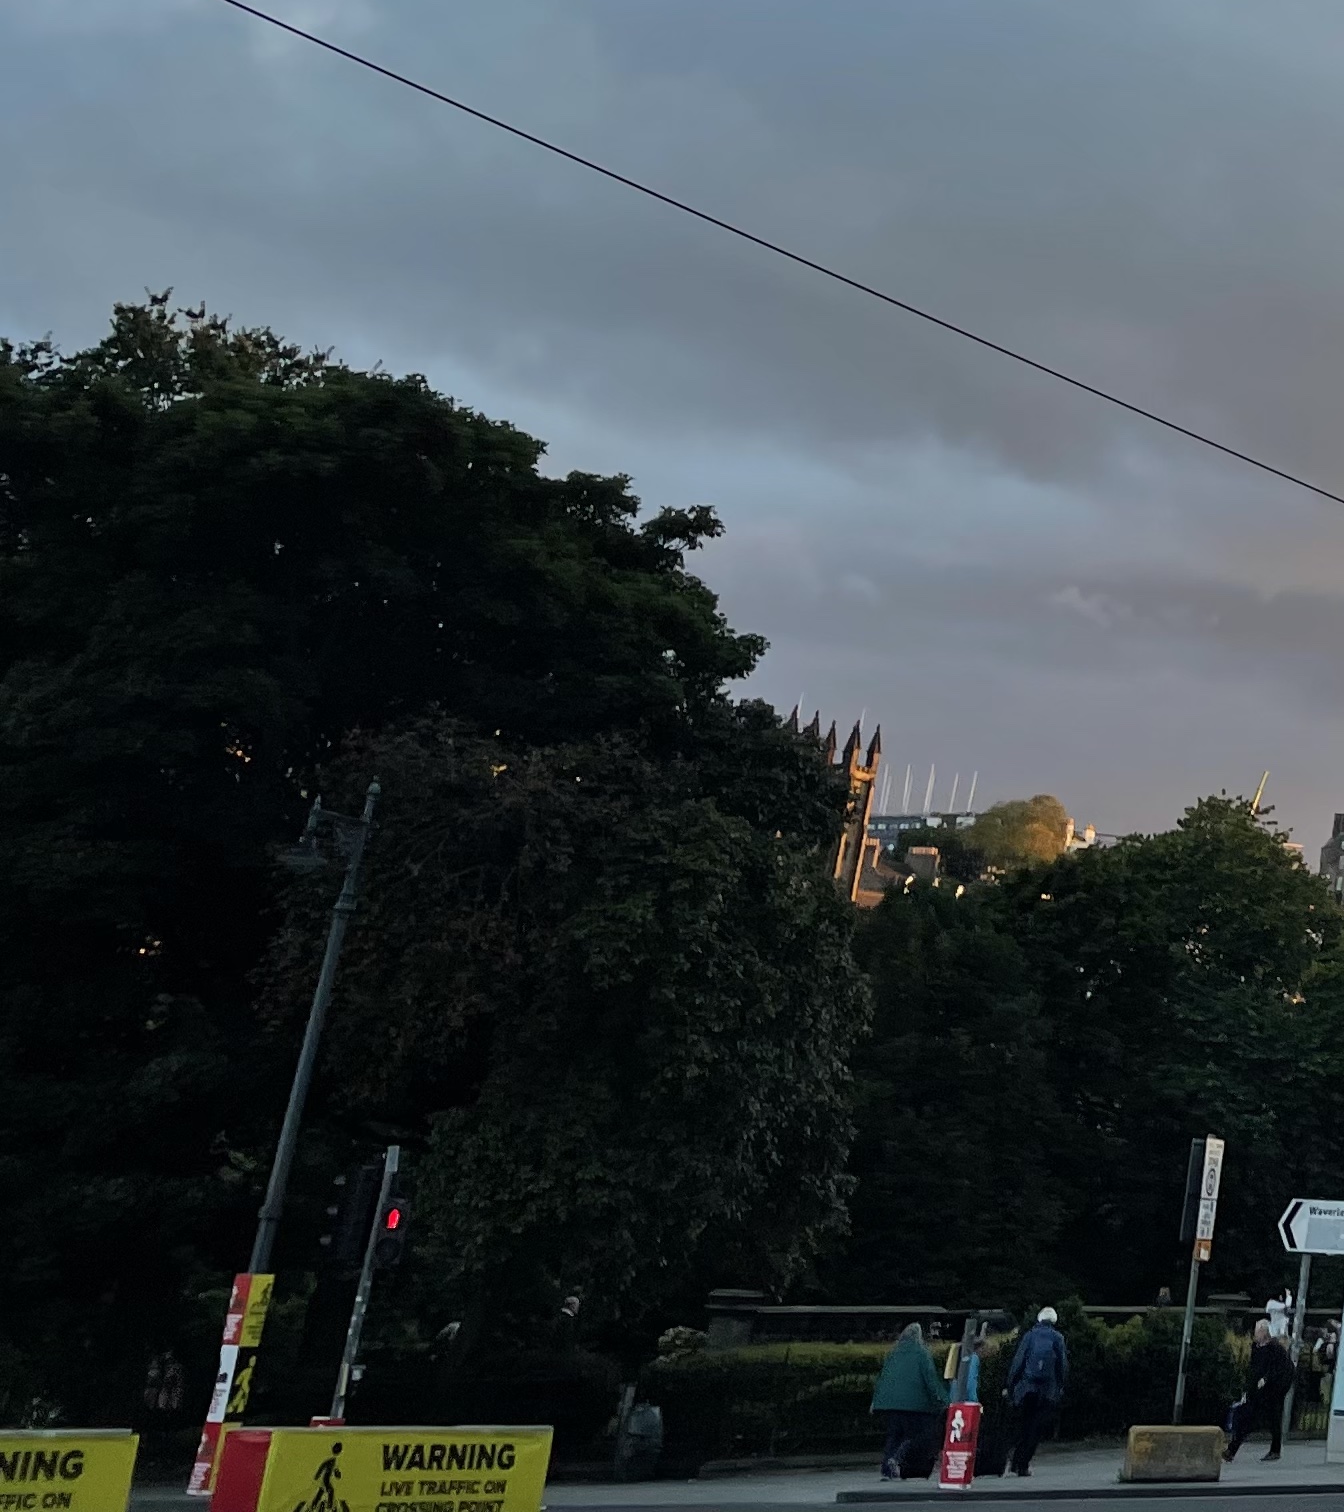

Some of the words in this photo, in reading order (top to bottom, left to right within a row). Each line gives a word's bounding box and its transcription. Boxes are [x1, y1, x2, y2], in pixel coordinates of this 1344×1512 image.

[383, 1444, 515, 1471] WARNING
[379, 1480, 413, 1497] LIVE
[418, 1480, 480, 1495] TRAFFIC
[483, 1479, 506, 1494] ON
[42, 1492, 72, 1509] ON
[457, 1500, 503, 1512] POINT
